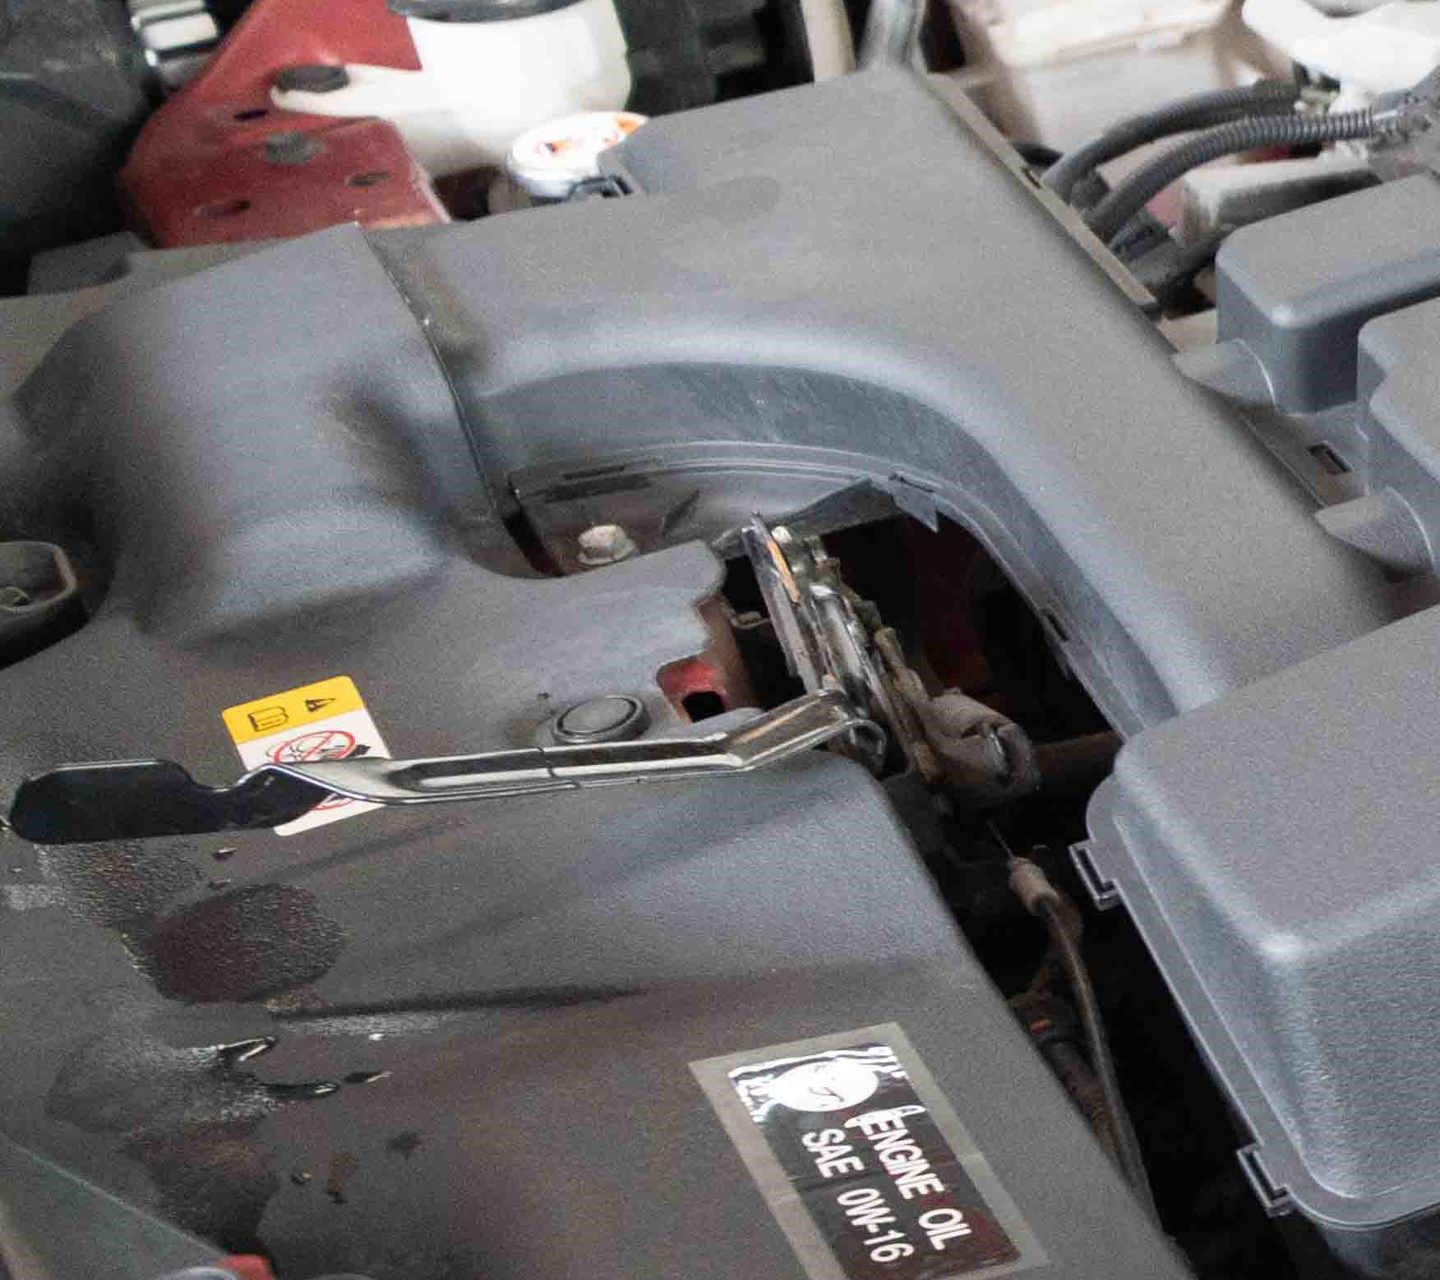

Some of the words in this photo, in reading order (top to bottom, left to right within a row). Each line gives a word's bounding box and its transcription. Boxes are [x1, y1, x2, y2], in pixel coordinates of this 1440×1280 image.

[801, 1127, 865, 1180] SAE
[836, 1187, 915, 1263] 0W-16
[860, 1110, 946, 1200] ENGINE
[918, 1207, 973, 1251] OIL
